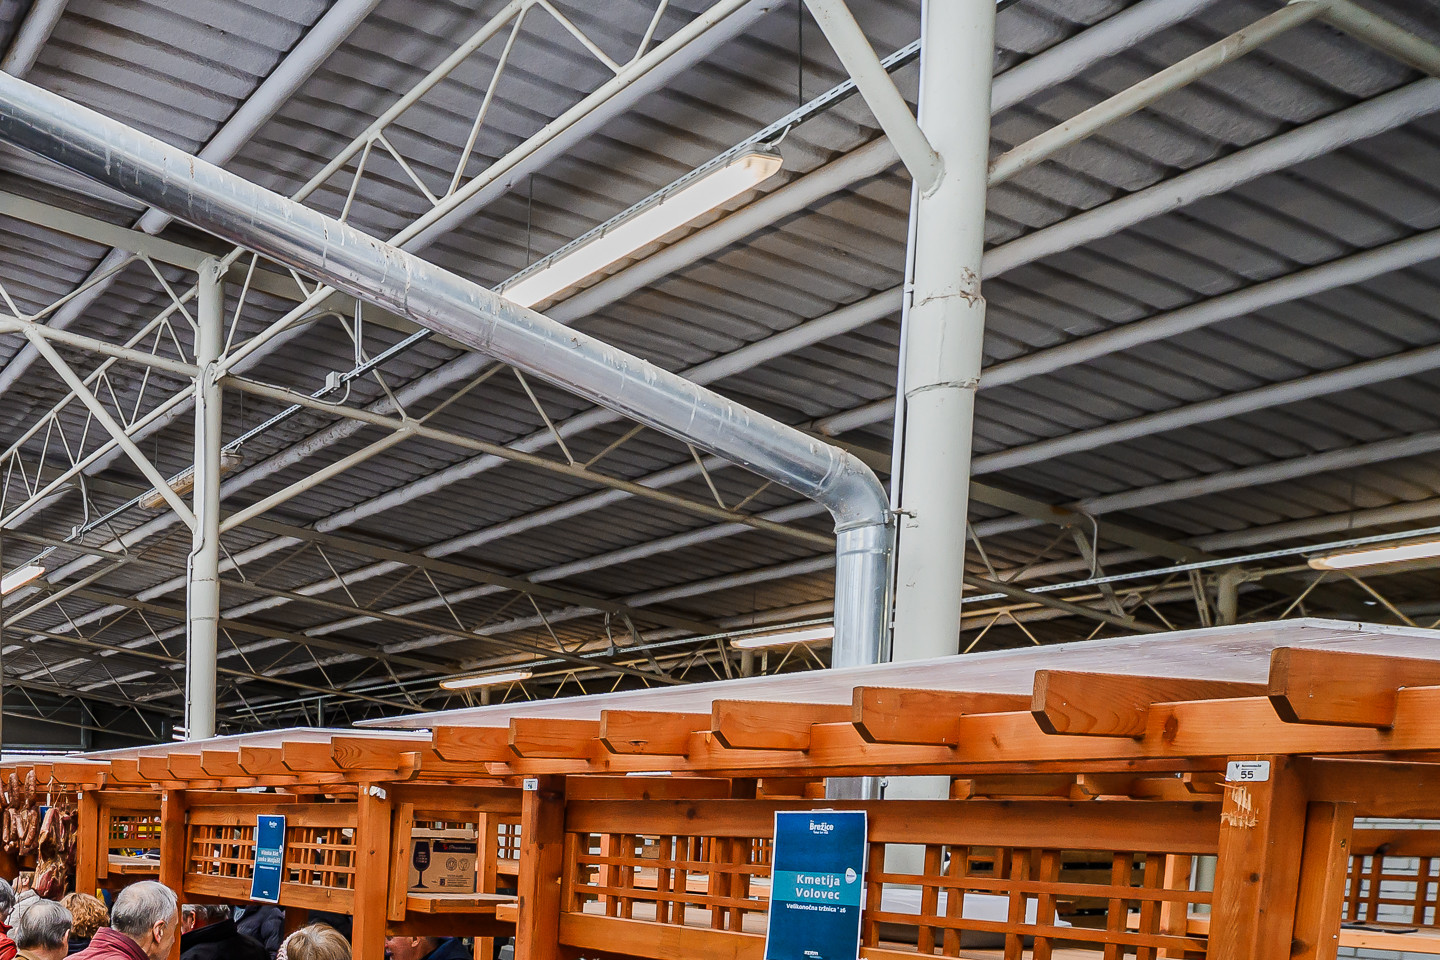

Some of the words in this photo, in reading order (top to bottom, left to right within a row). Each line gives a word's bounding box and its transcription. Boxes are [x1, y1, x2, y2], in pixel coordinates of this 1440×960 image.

[1241, 771, 1254, 779] 55
[809, 822, 834, 832] Brežice
[797, 874, 840, 888] Kmetija
[795, 887, 840, 900] Volovec
[786, 903, 817, 911] Velikonočna
[819, 905, 837, 913] tržnica
